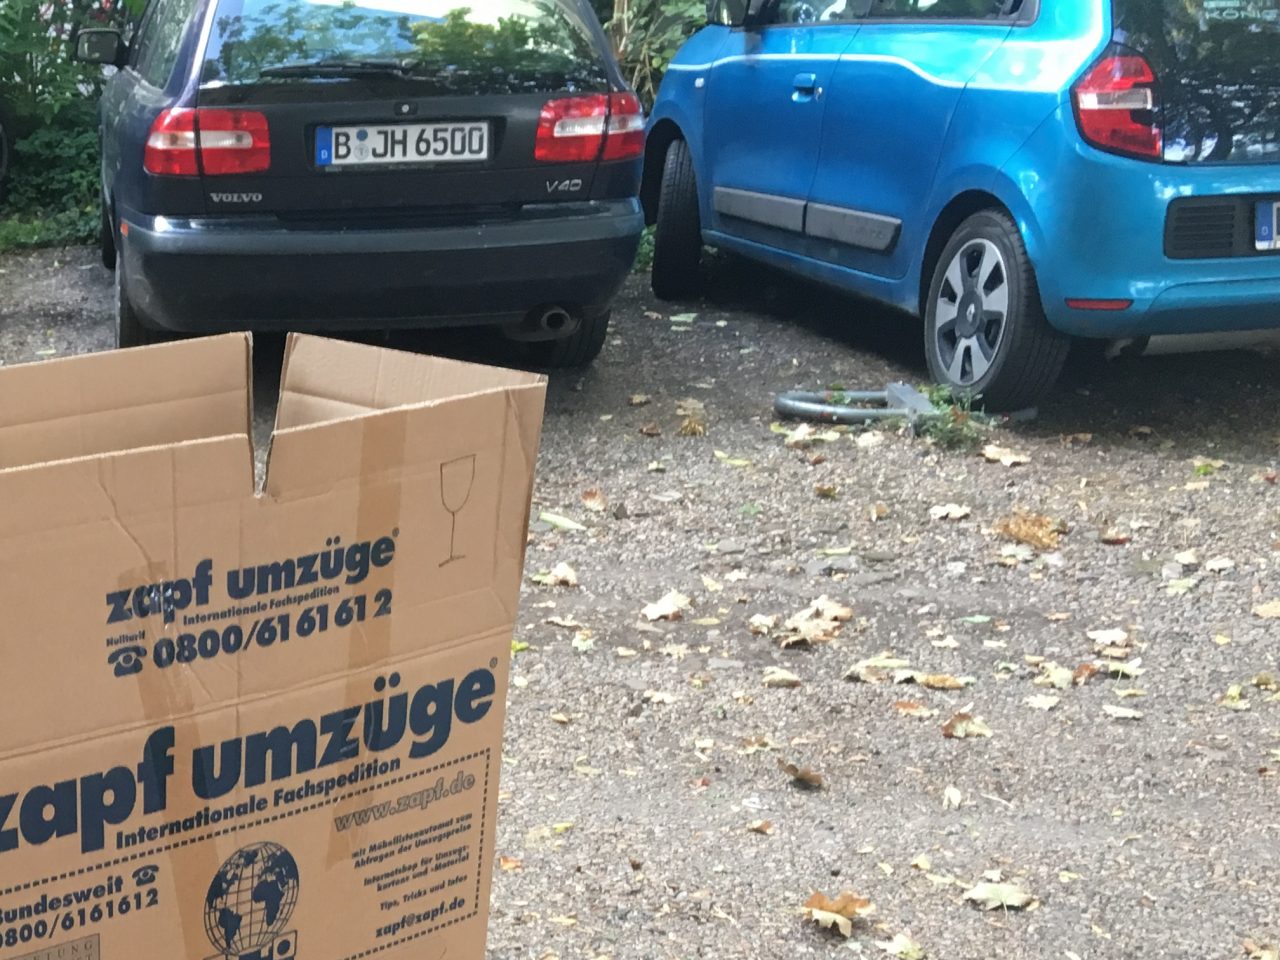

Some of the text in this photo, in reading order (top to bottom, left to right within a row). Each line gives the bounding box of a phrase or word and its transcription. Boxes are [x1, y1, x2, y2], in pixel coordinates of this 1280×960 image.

[333, 126, 485, 161] B JH 6500
[210, 192, 263, 203] VOLVO
[546, 178, 583, 193] V40
[106, 535, 396, 625] zapf umzüge
[183, 584, 340, 626] Internationale Fachspedition
[152, 587, 394, 669] 0800/61 61 61 2
[191, 671, 497, 800] umzüge
[116, 757, 401, 850] Internationale Fachspedition
[333, 769, 476, 833] www.zapf.de
[354, 850, 395, 869] Abfragen
[414, 823, 472, 848] Umzugspreise
[420, 855, 433, 867] für
[403, 889, 427, 903] Tricks
[429, 880, 446, 894] und
[447, 874, 468, 887] Infos
[376, 896, 466, 938] zapf@zapf.de
